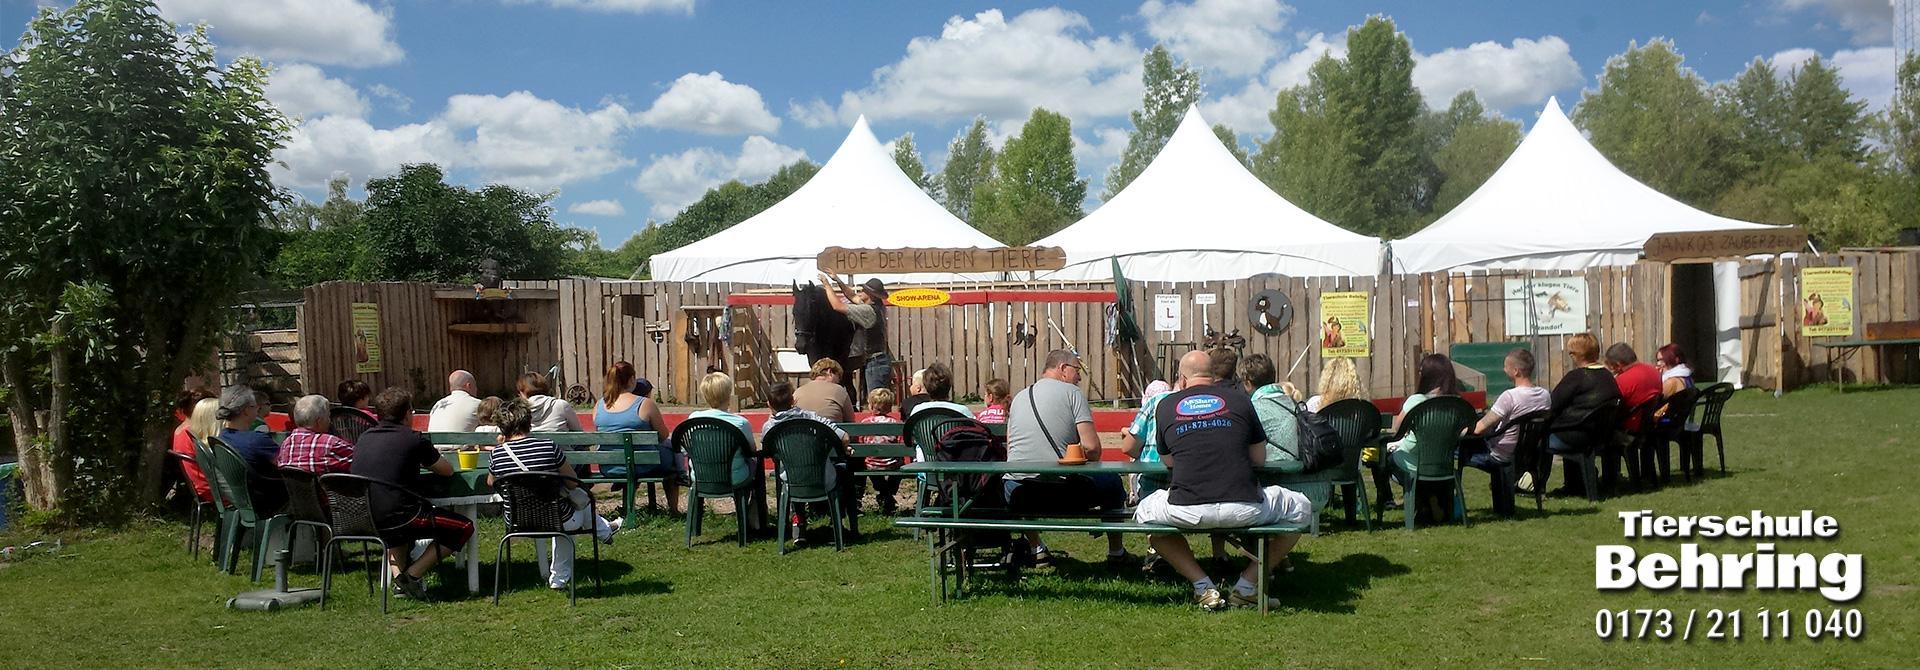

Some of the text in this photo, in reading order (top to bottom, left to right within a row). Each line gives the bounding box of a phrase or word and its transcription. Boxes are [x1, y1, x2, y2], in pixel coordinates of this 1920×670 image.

[1654, 234, 1803, 253] JANKOS ZAUBERZELT
[835, 249, 1048, 270] HOF DER KLUGEN TIERE
[1563, 282, 1579, 293] Tiere
[896, 294, 941, 302] SHOW-ARENA
[1176, 419, 1232, 436] 781-878-4026
